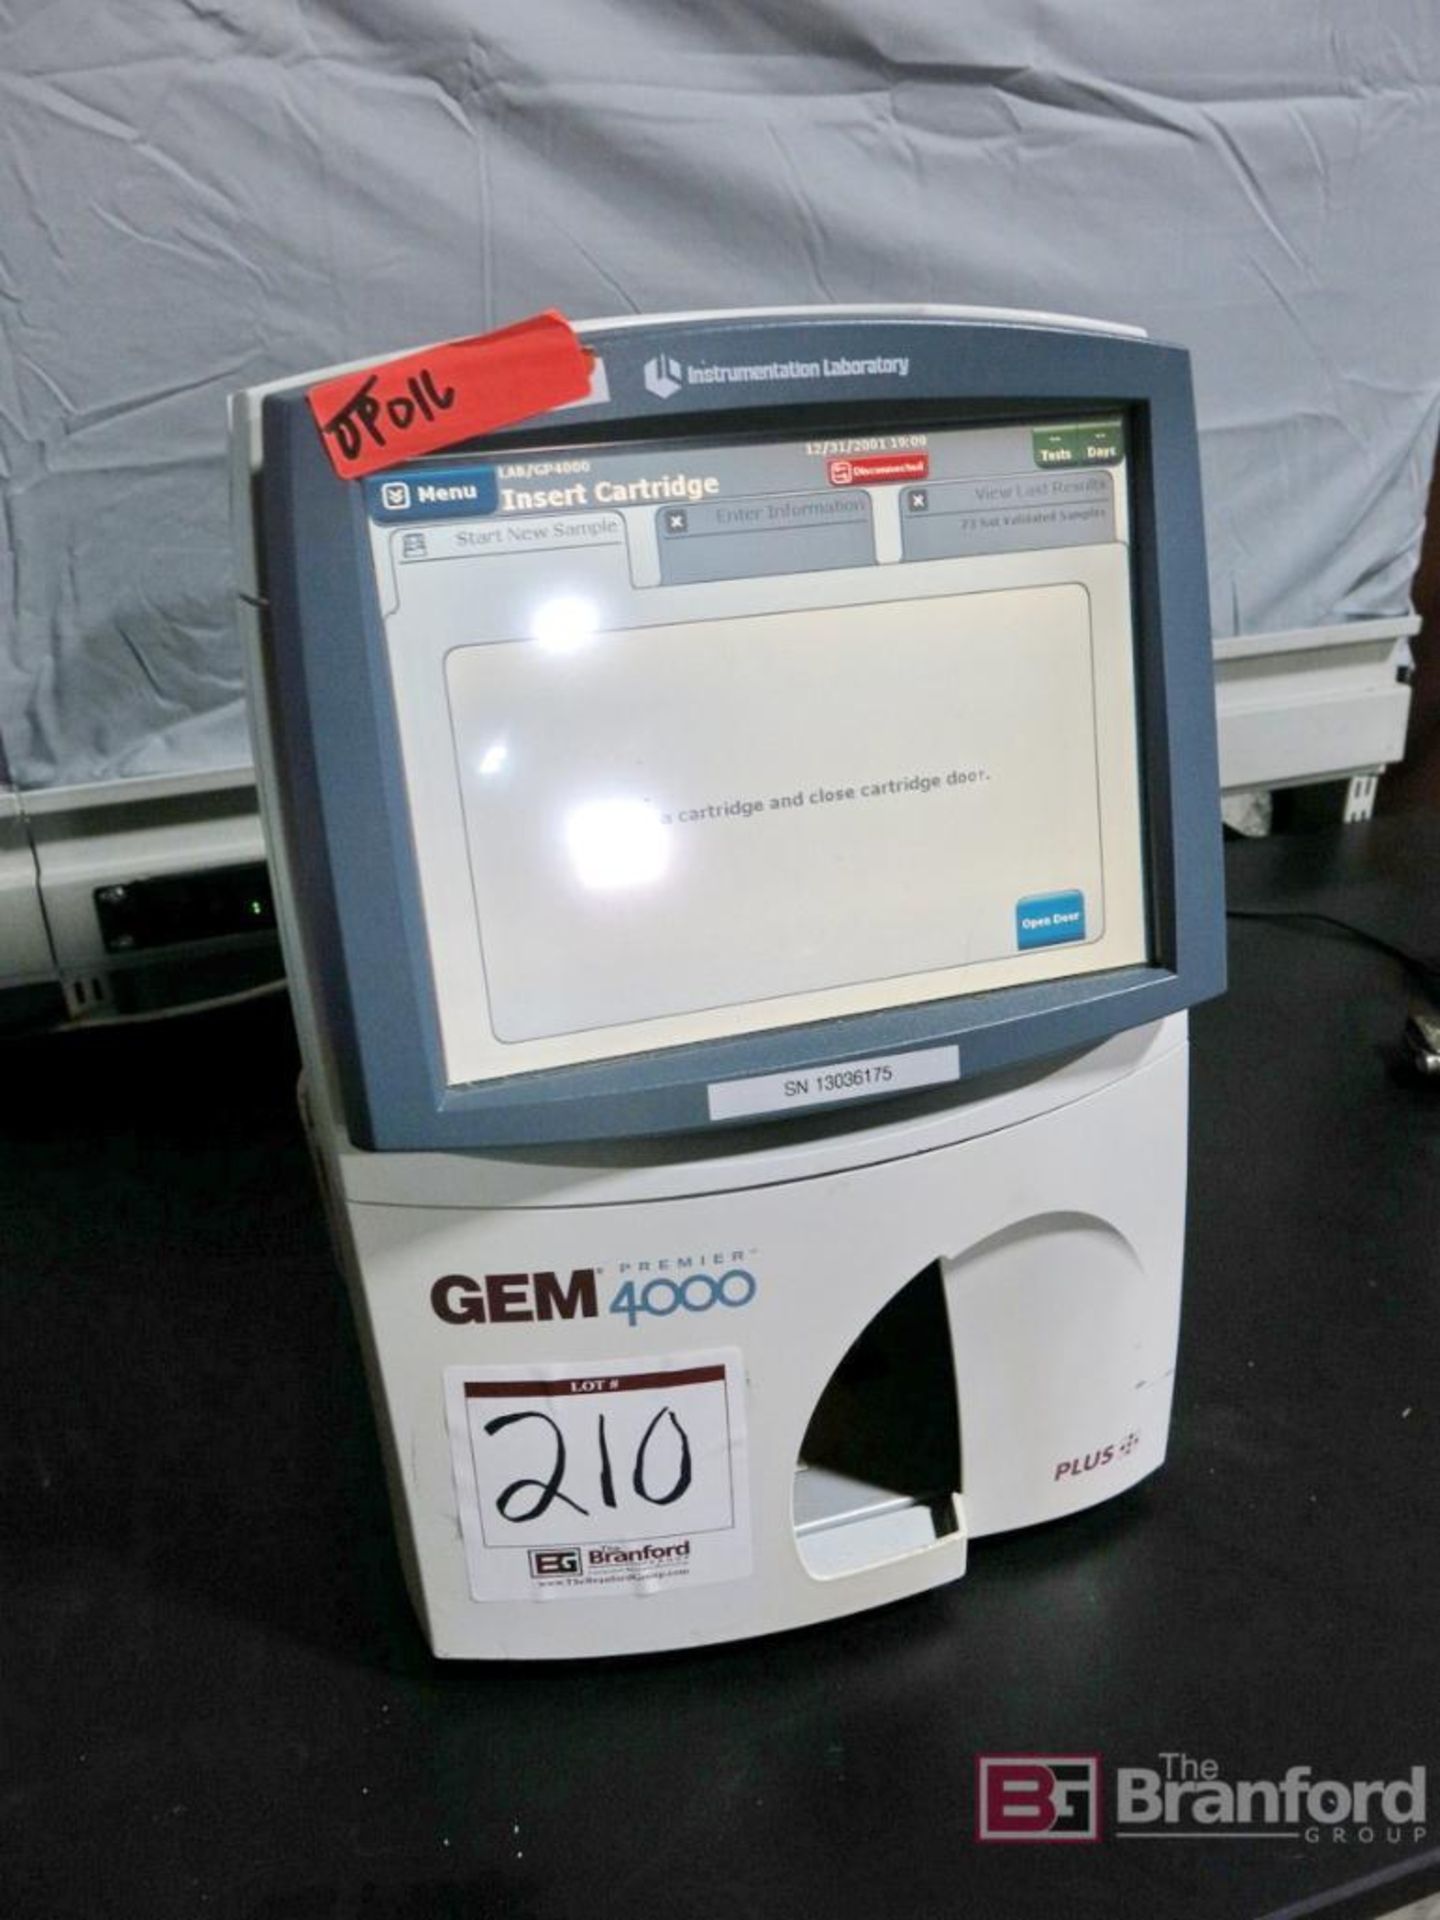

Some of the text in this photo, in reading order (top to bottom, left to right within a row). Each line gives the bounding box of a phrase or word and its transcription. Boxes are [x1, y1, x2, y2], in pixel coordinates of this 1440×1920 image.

[687, 357, 909, 385] Instrumentation Laboratory
[1041, 449, 1072, 462] Tests
[417, 484, 478, 502] Menu
[501, 474, 720, 510] Insert Cartridge
[975, 478, 1106, 500] View Last Results
[716, 499, 866, 524] Enter Information
[455, 518, 619, 547] Start New Sample
[678, 798, 764, 823] cartridge
[769, 793, 804, 811] and
[809, 786, 855, 804] close
[860, 774, 941, 799] cartridge
[945, 768, 991, 786] door.
[1021, 916, 1051, 931] Open
[784, 1066, 893, 1097] SN 13036175
[619, 1250, 744, 1273] PREMIER
[430, 1266, 756, 1327] GEM 4000
[570, 1379, 620, 1393] LOT #
[483, 1405, 692, 1523] 210
[1053, 1444, 1115, 1483] PLUS
[588, 1539, 690, 1565] Branford
